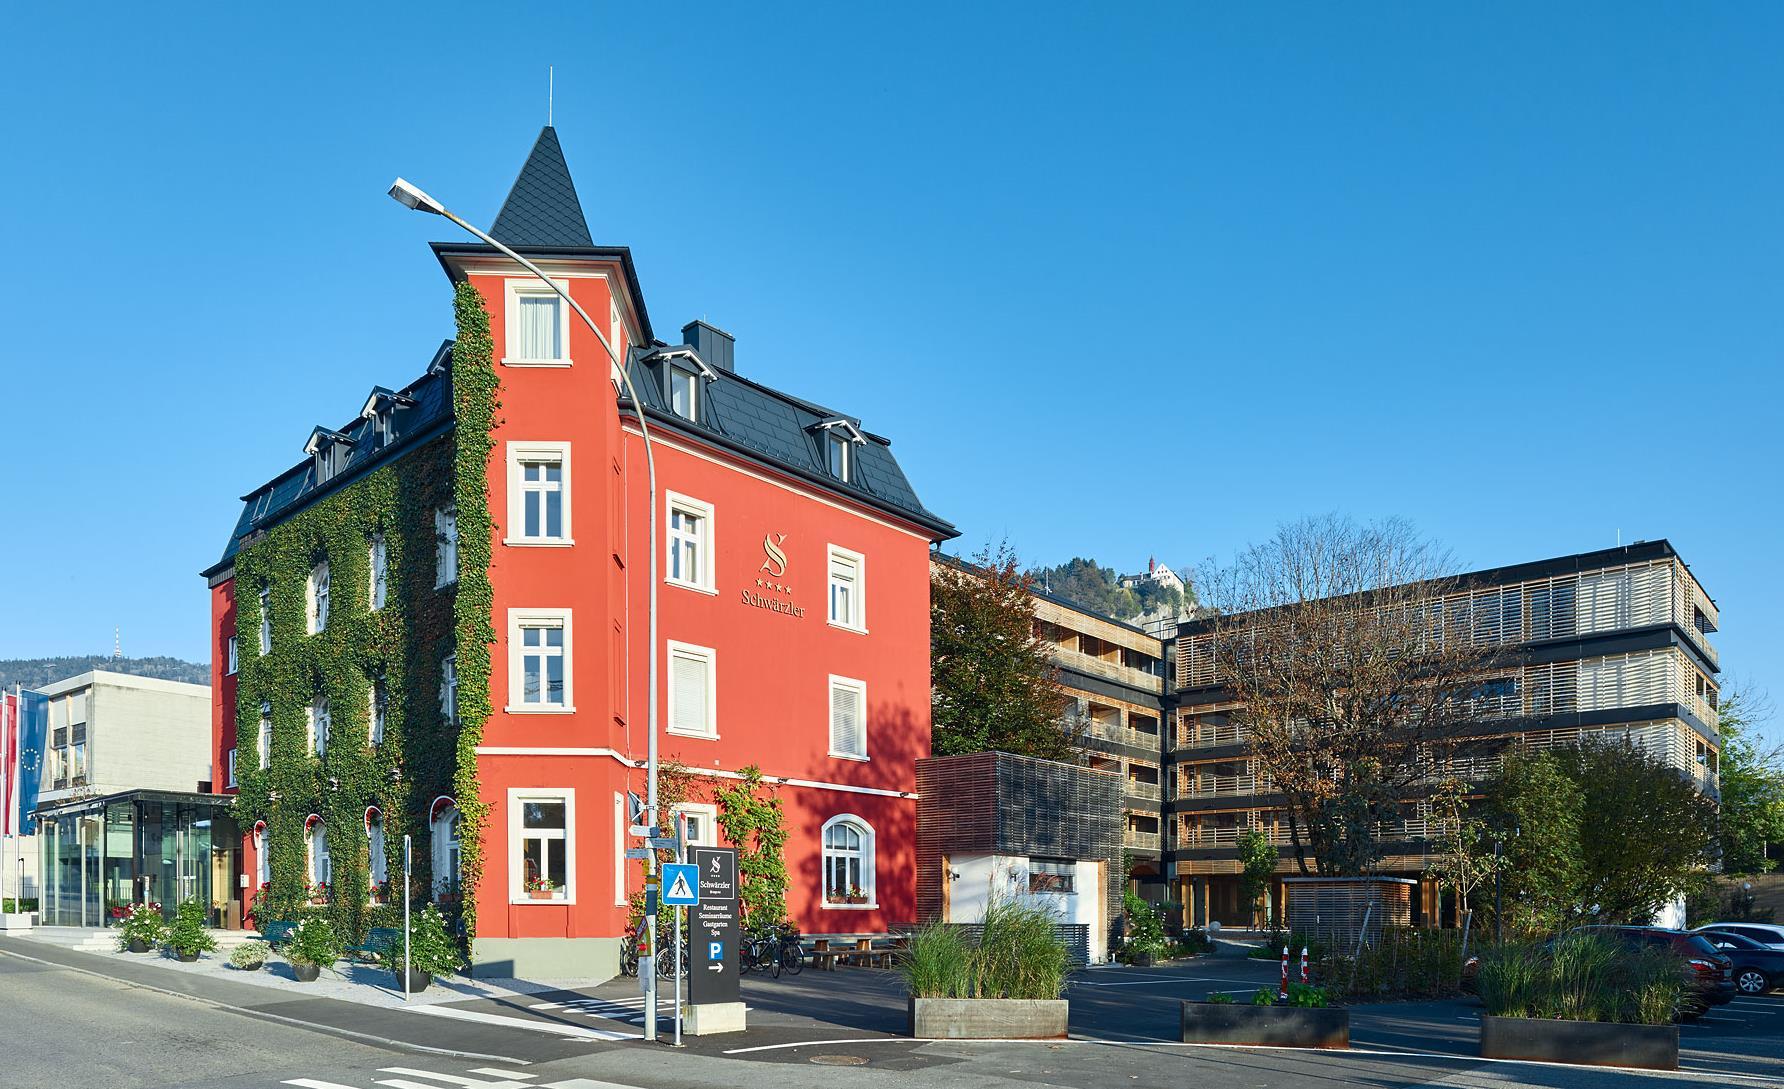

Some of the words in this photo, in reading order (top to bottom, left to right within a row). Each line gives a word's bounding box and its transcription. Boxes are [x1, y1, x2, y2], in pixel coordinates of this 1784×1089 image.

[741, 589, 805, 618] Schwärzler
[700, 880, 731, 889] Schwärzler
[703, 921, 728, 929] Gastgarten
[711, 929, 720, 937] Spa
[710, 943, 721, 959] P
